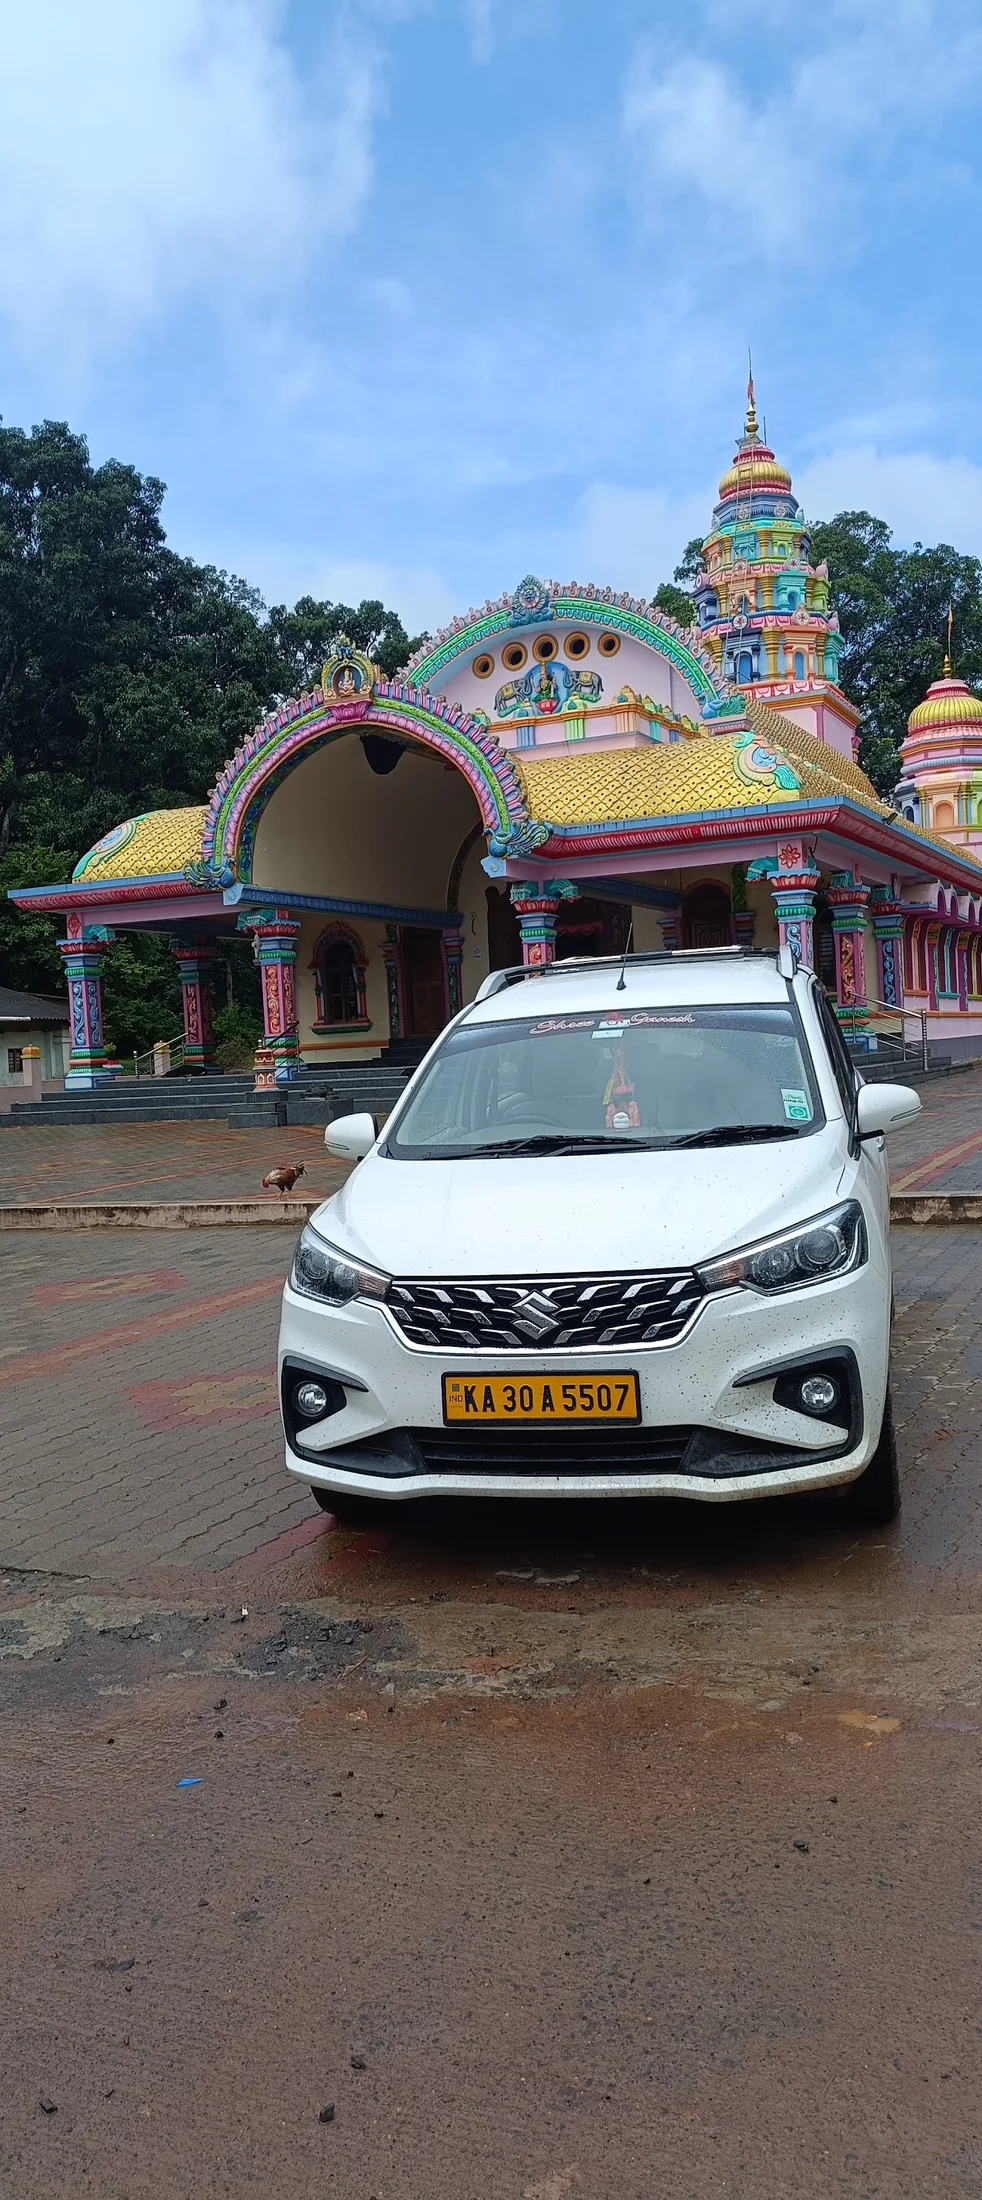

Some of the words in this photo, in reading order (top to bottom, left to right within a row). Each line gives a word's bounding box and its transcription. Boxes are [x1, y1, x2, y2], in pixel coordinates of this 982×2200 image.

[530, 1019, 596, 1035] Shree
[629, 1012, 696, 1026] Ganesh
[449, 1394, 464, 1403] IND
[464, 1385, 497, 1412] KA
[502, 1384, 534, 1412] 30
[541, 1384, 556, 1412] A
[561, 1384, 629, 1412] 5507
